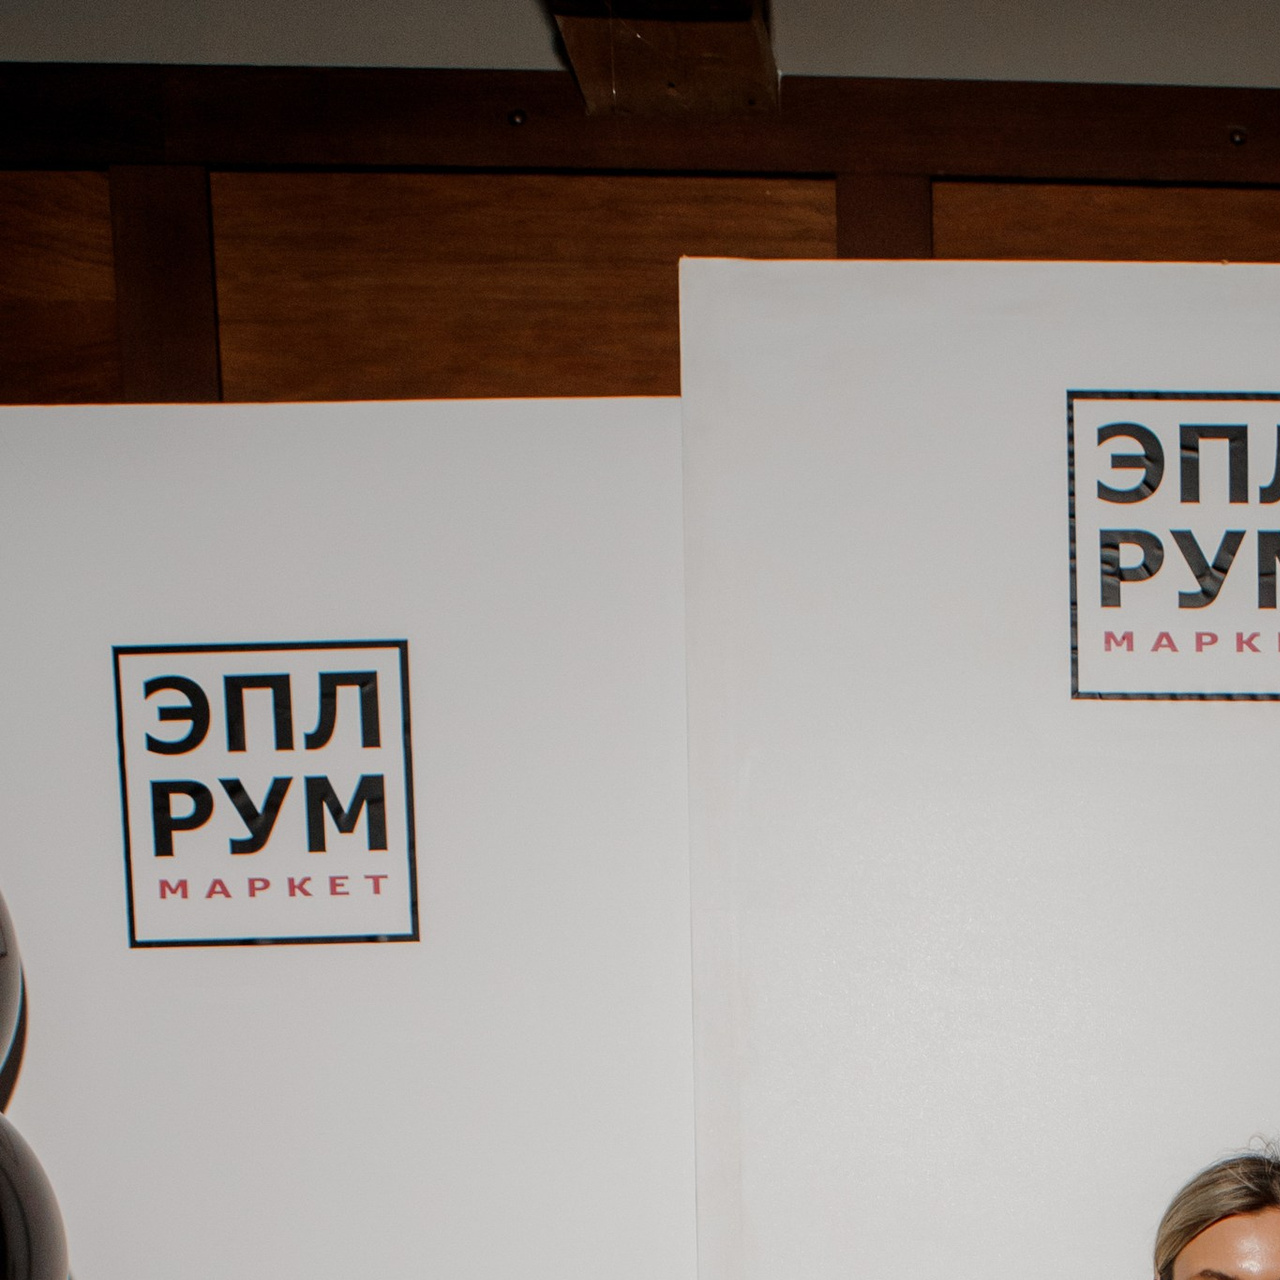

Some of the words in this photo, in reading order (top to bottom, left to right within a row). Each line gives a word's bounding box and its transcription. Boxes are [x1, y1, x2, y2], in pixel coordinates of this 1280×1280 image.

[143, 670, 381, 755] ЭПЛ
[150, 774, 388, 857] РУМ
[158, 875, 388, 899] МАРКЕТ
